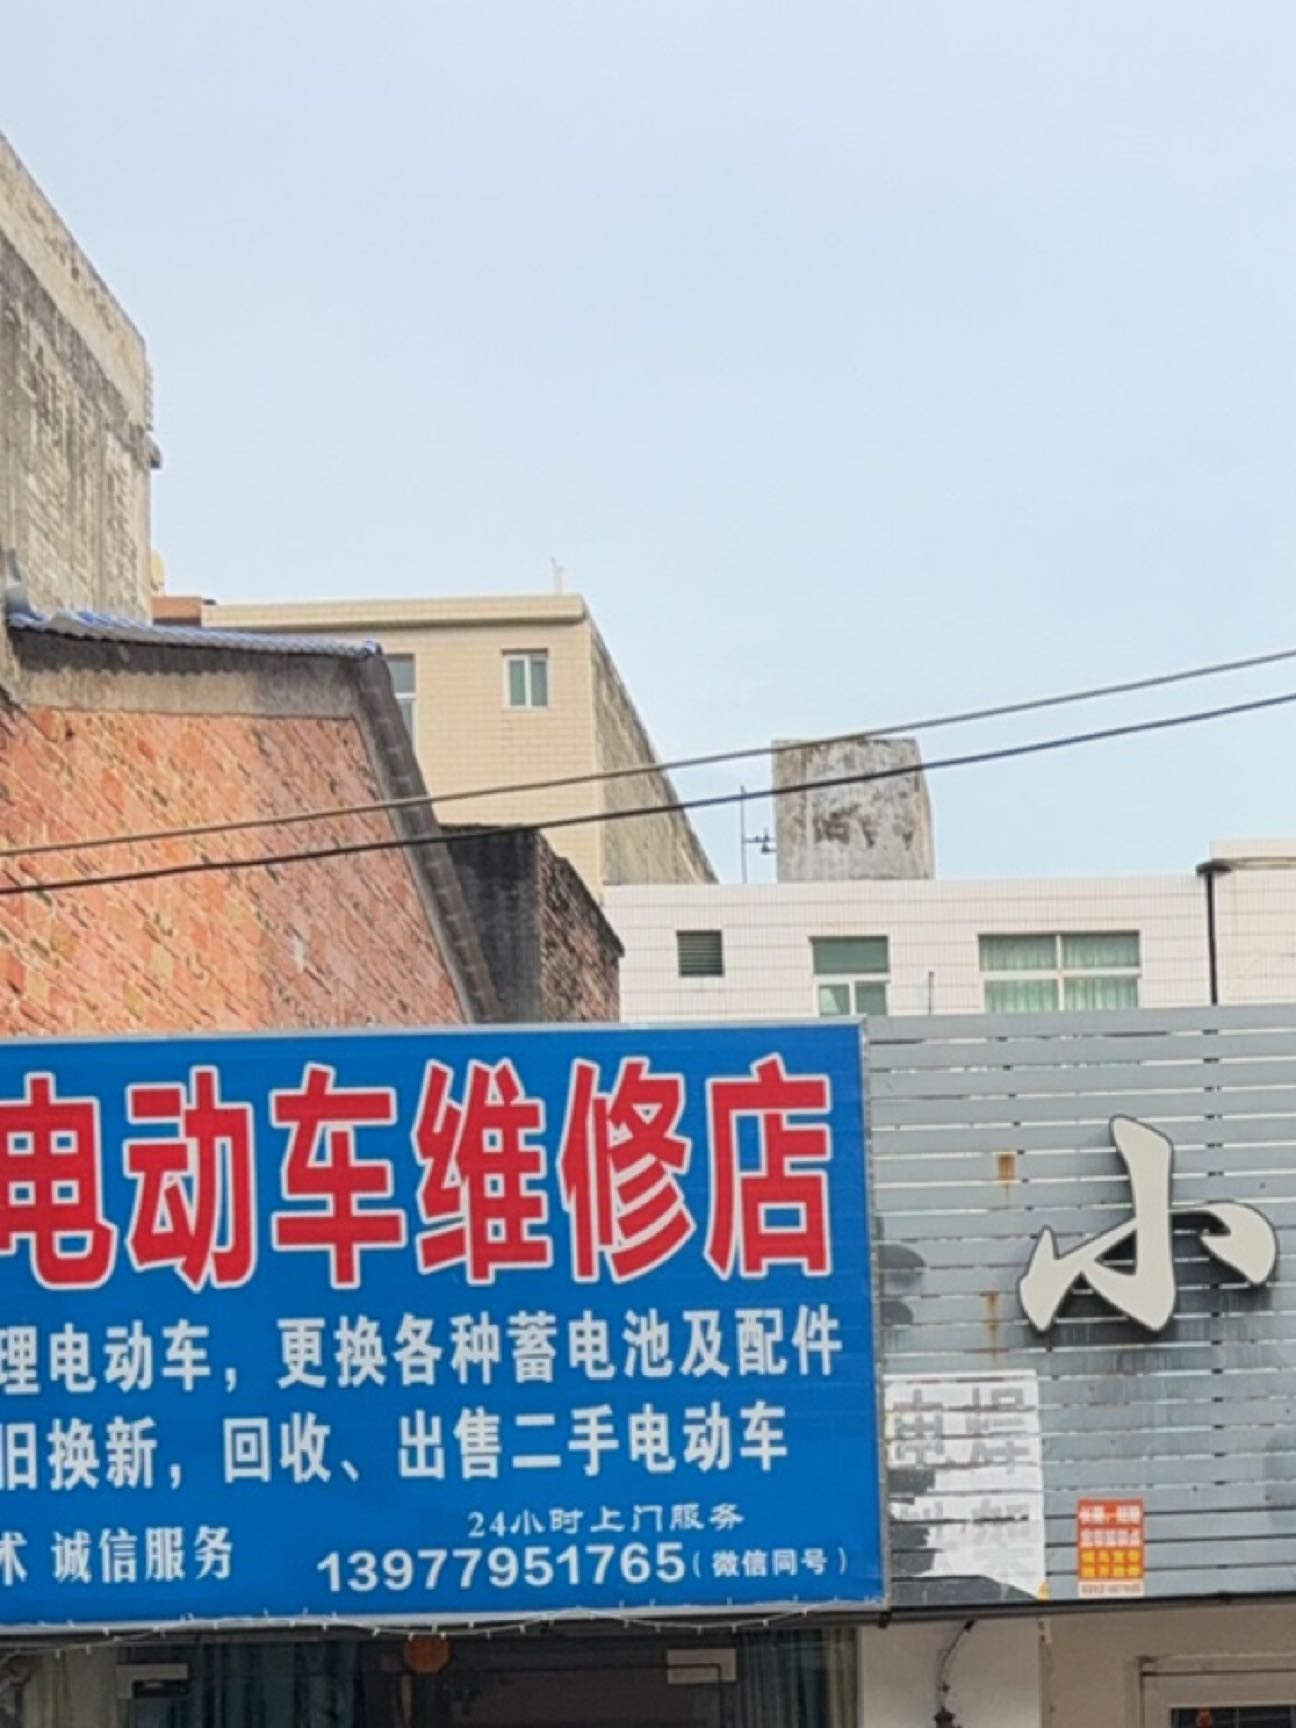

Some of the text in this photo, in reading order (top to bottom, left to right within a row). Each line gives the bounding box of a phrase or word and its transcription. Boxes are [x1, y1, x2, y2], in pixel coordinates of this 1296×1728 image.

[0, 1053, 833, 1292] 电动车维修店
[468, 1504, 743, 1539] 24小时上门服务
[52, 1525, 233, 1583] 诚信服务
[317, 1541, 686, 1592] 13977951765
